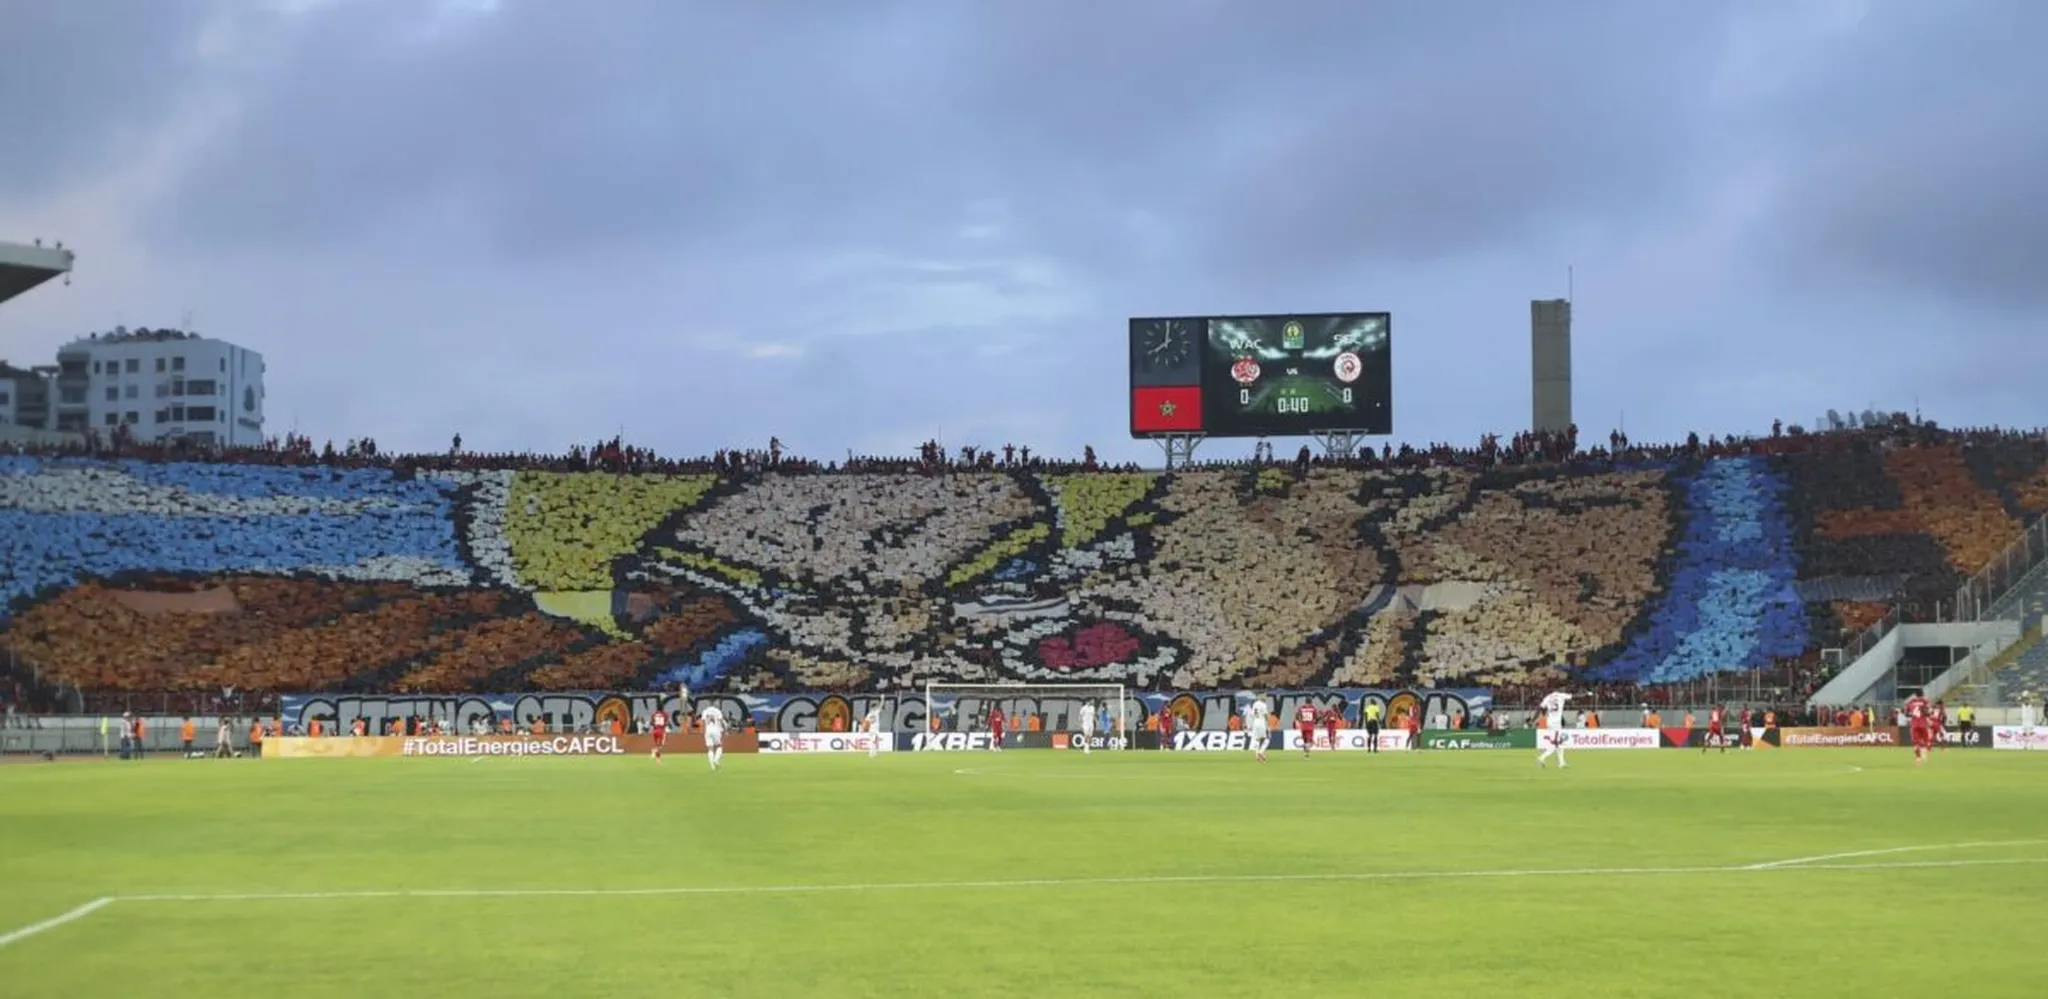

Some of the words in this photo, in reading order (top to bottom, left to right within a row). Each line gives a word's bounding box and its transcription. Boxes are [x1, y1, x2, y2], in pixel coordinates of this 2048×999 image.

[1229, 339, 1263, 350] WAC
[1240, 389, 1249, 404] 0
[1343, 387, 1352, 403] 0
[1277, 397, 1308, 413] 0:40
[403, 736, 624, 755] #TotalEnergiesCAFCL
[769, 738, 822, 750] QNET
[1352, 736, 1402, 748] QET
[1572, 734, 1654, 746] TotalEnergies
